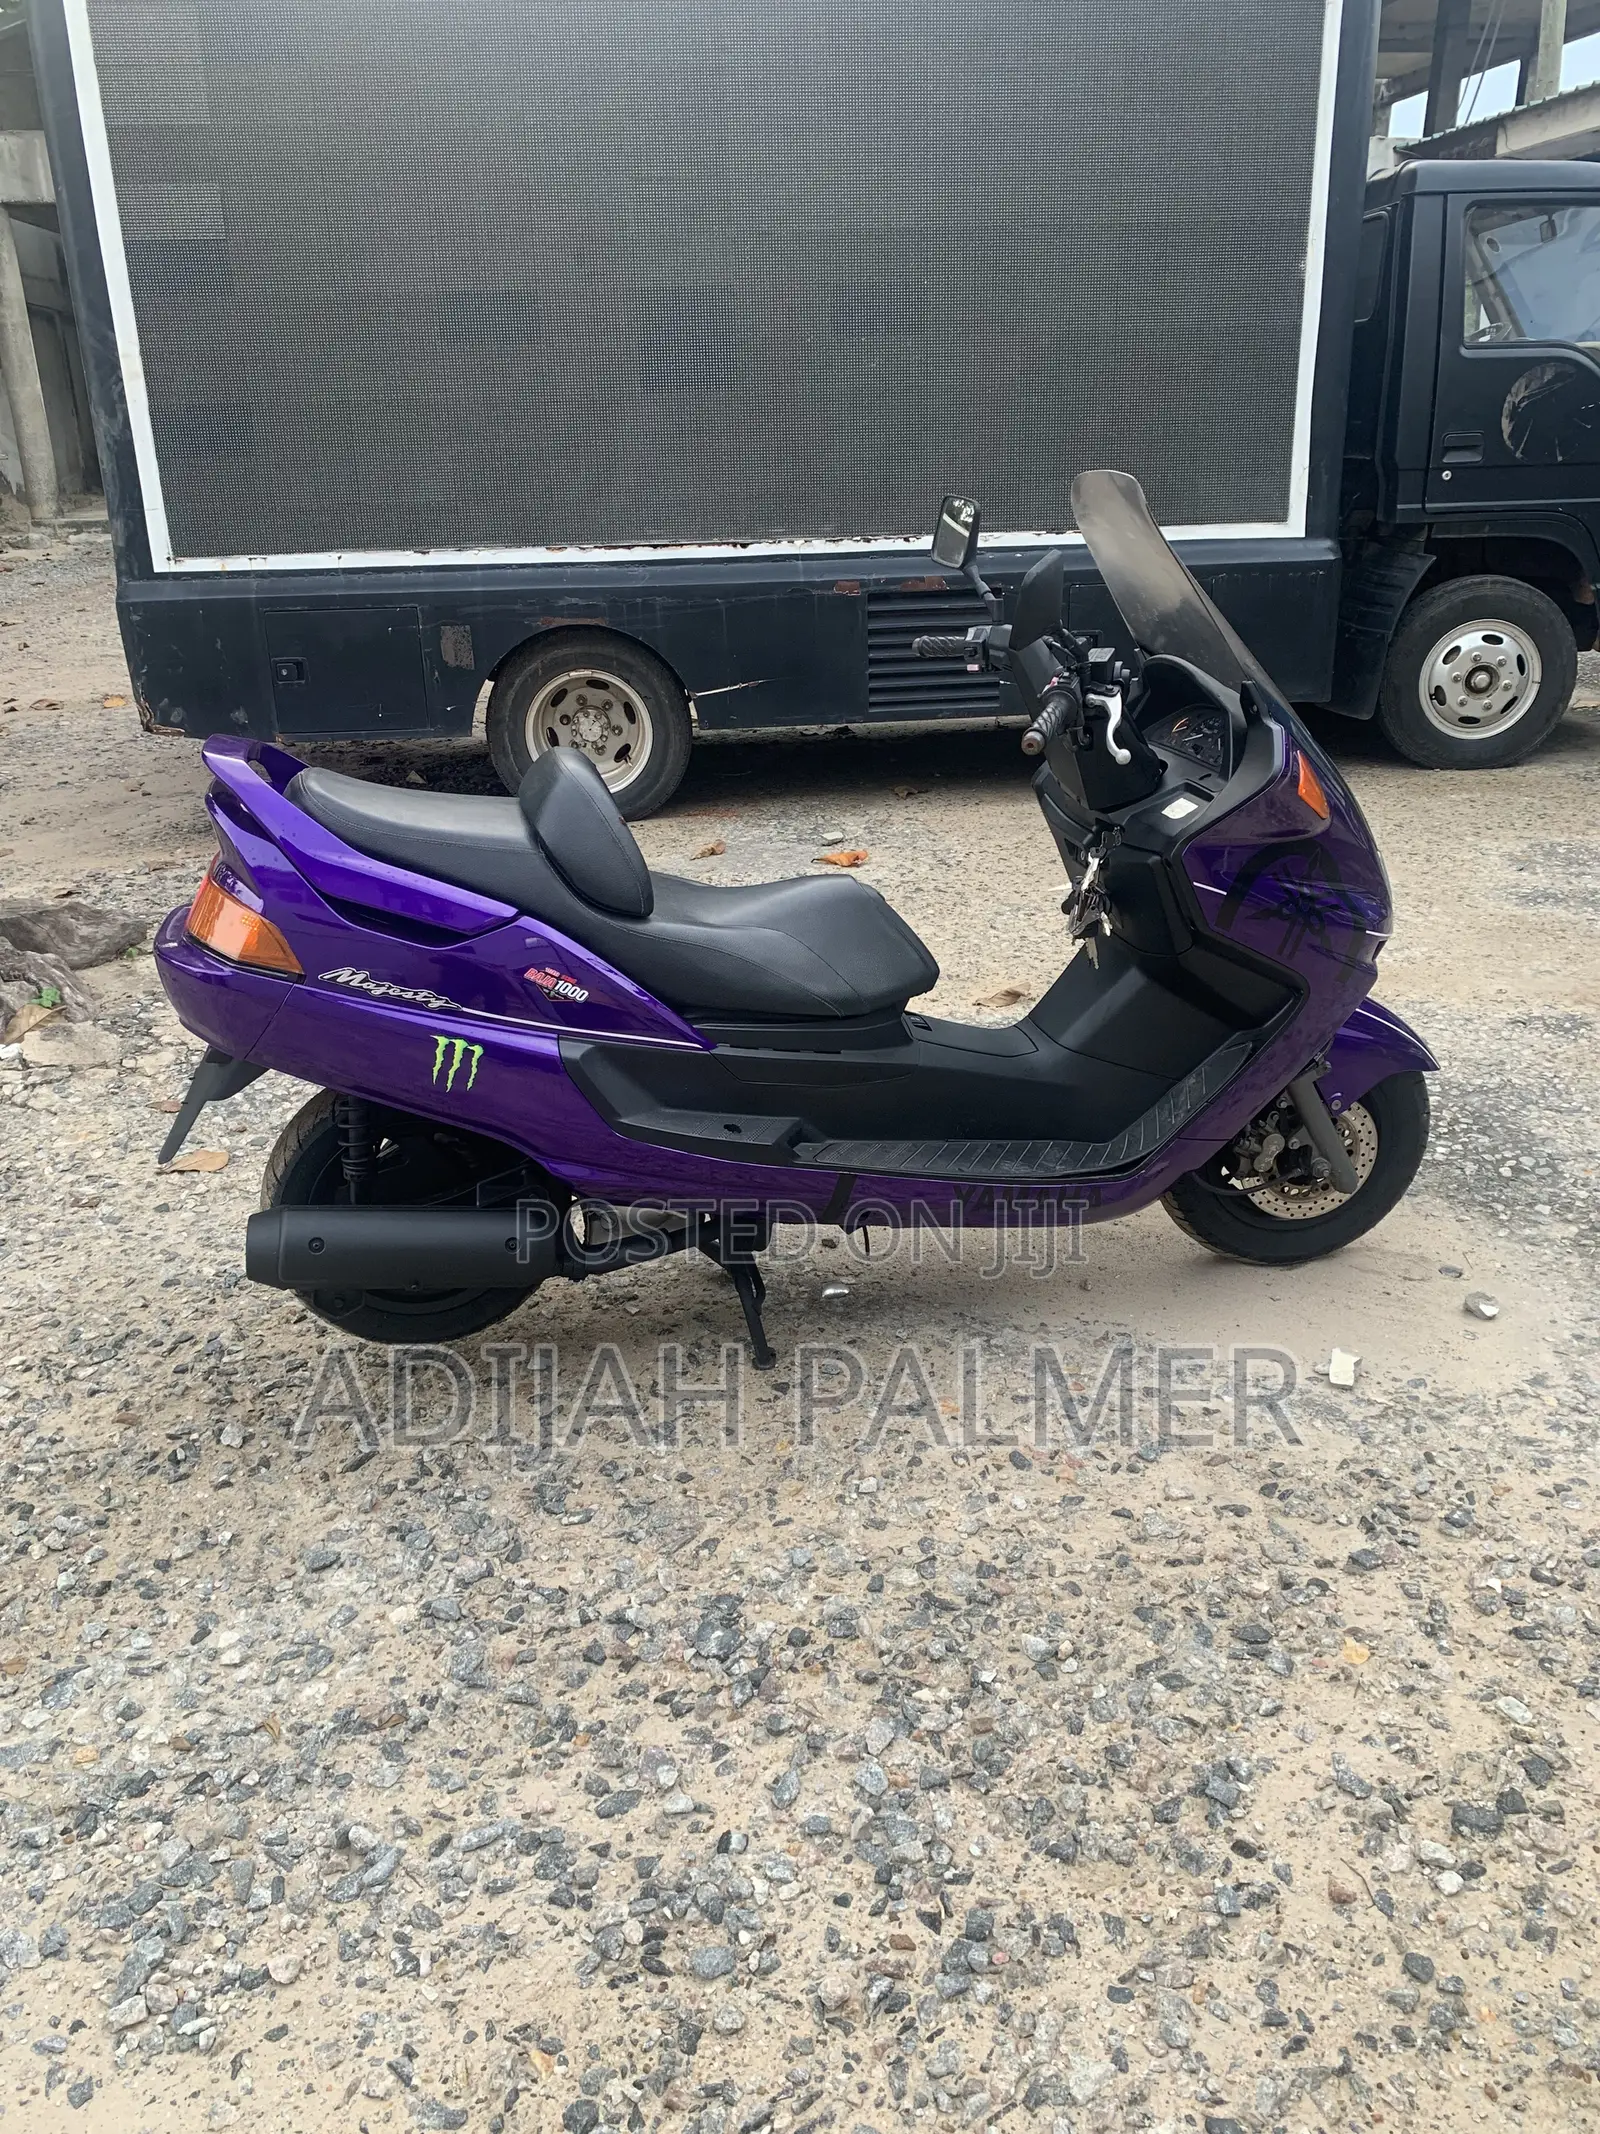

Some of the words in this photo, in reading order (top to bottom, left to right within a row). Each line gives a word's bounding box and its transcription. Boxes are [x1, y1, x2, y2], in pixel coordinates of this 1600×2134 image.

[320, 968, 460, 1009] Majesty
[524, 967, 558, 989] BAJA
[554, 980, 589, 1003] 1000
